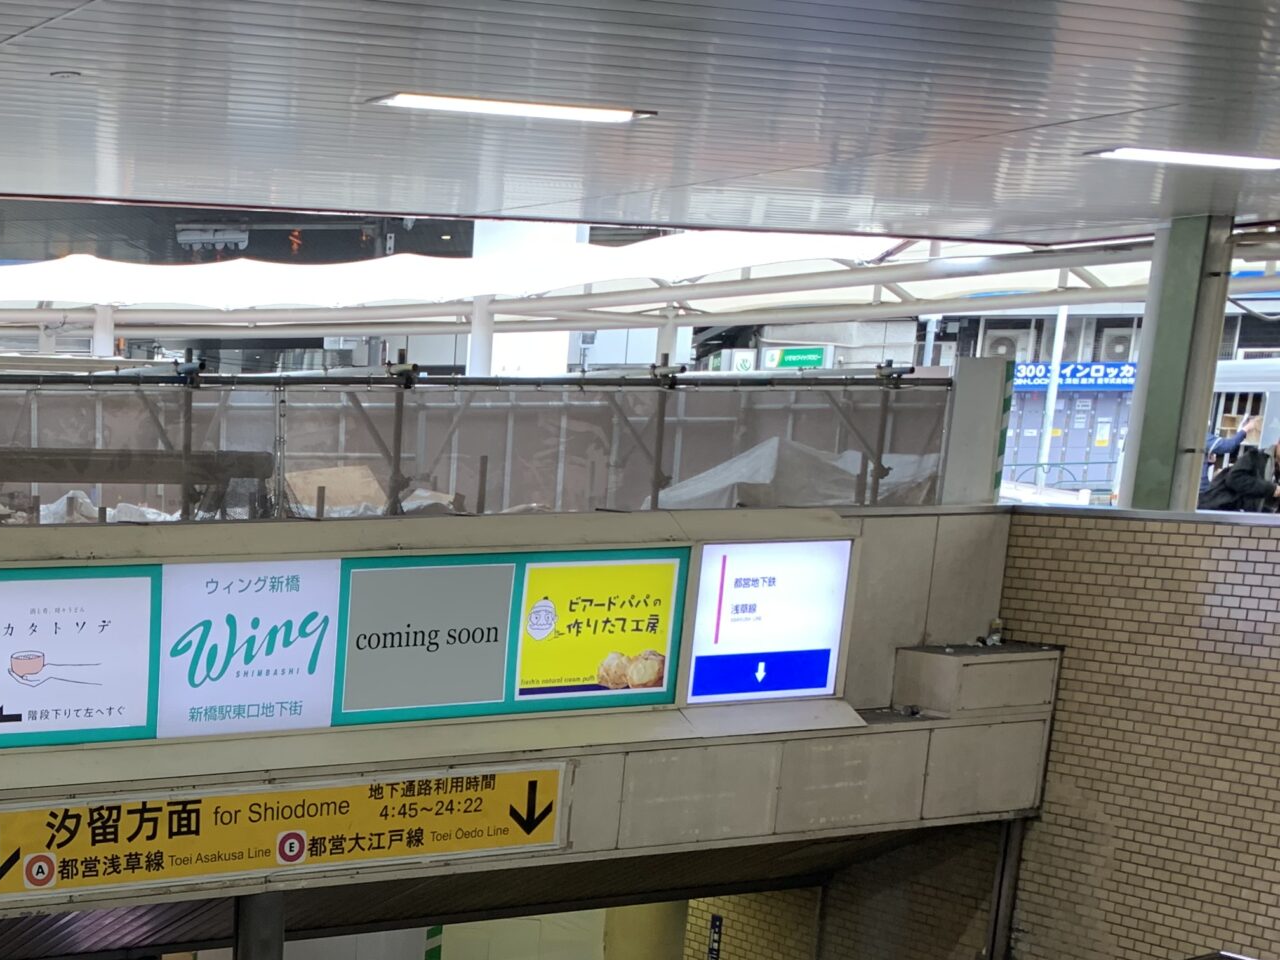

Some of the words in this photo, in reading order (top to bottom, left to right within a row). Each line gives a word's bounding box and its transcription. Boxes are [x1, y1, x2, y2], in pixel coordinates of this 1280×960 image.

[205, 575, 301, 595] ウィング新橋
[734, 576, 776, 589] 都営地下鉄
[569, 594, 662, 612] ビアードパパの
[730, 603, 757, 615] 浅草線
[3, 620, 111, 637] カタトソデ
[566, 614, 660, 637] 作りたて工房
[356, 623, 439, 653] coming
[446, 626, 499, 646] soon
[169, 610, 330, 689] Wing
[235, 667, 301, 678] SHIMBASHI
[27, 705, 126, 721] 階段下りて左へすぐ
[188, 700, 303, 722] 新橋駅東口地下街
[368, 774, 496, 800] 地下通路利用時間
[45, 799, 202, 850] 汐留方面
[213, 806, 241, 826] for
[248, 799, 350, 823] Shiodome
[288, 842, 295, 853] E
[308, 828, 424, 858] 都営大江戸線
[431, 830, 452, 842] Toei
[487, 825, 509, 837] Line
[35, 865, 45, 876] A
[58, 850, 165, 881] 都営浅草線
[169, 854, 193, 867] Toei
[195, 849, 244, 864] Asakusa
[247, 846, 271, 859] Line
